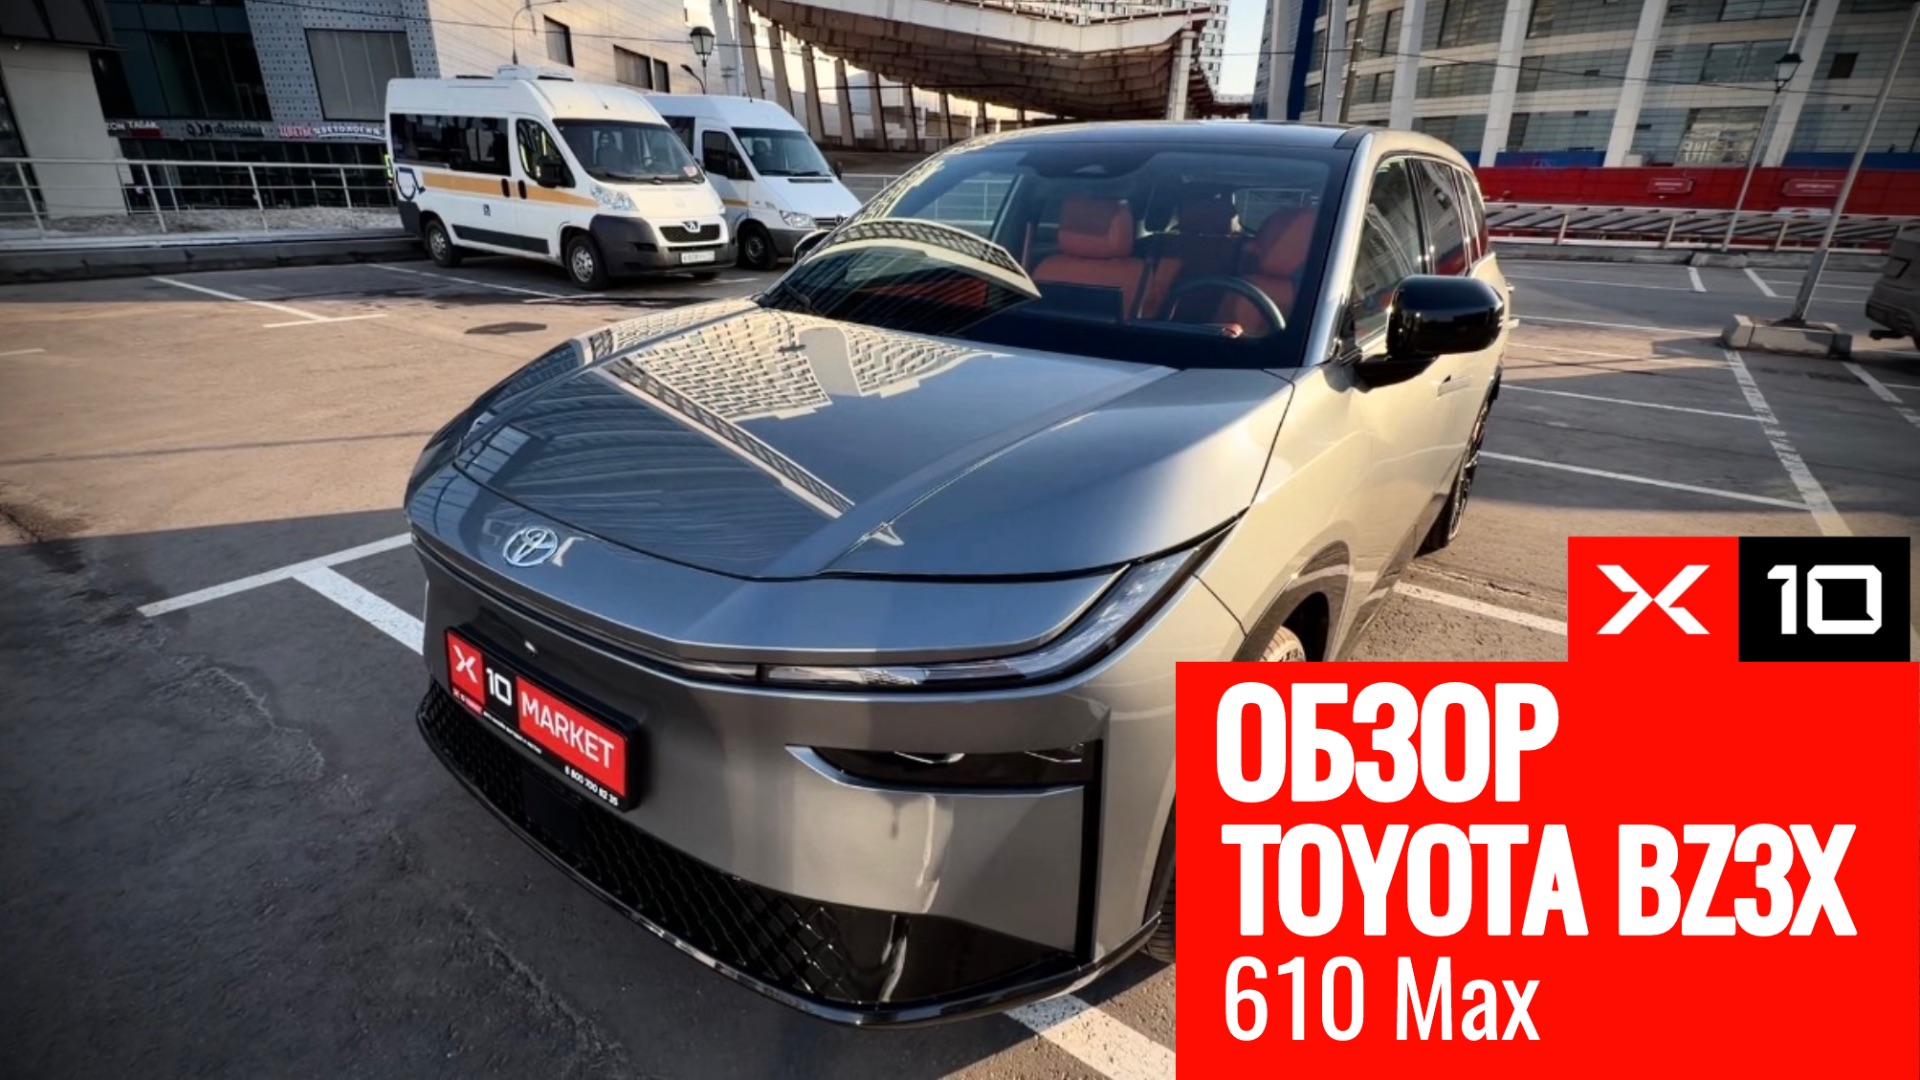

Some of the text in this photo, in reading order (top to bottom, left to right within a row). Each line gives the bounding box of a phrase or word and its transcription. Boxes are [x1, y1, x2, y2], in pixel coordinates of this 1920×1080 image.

[453, 645, 478, 683] X
[486, 668, 512, 706] 10
[521, 691, 614, 769] MARKET
